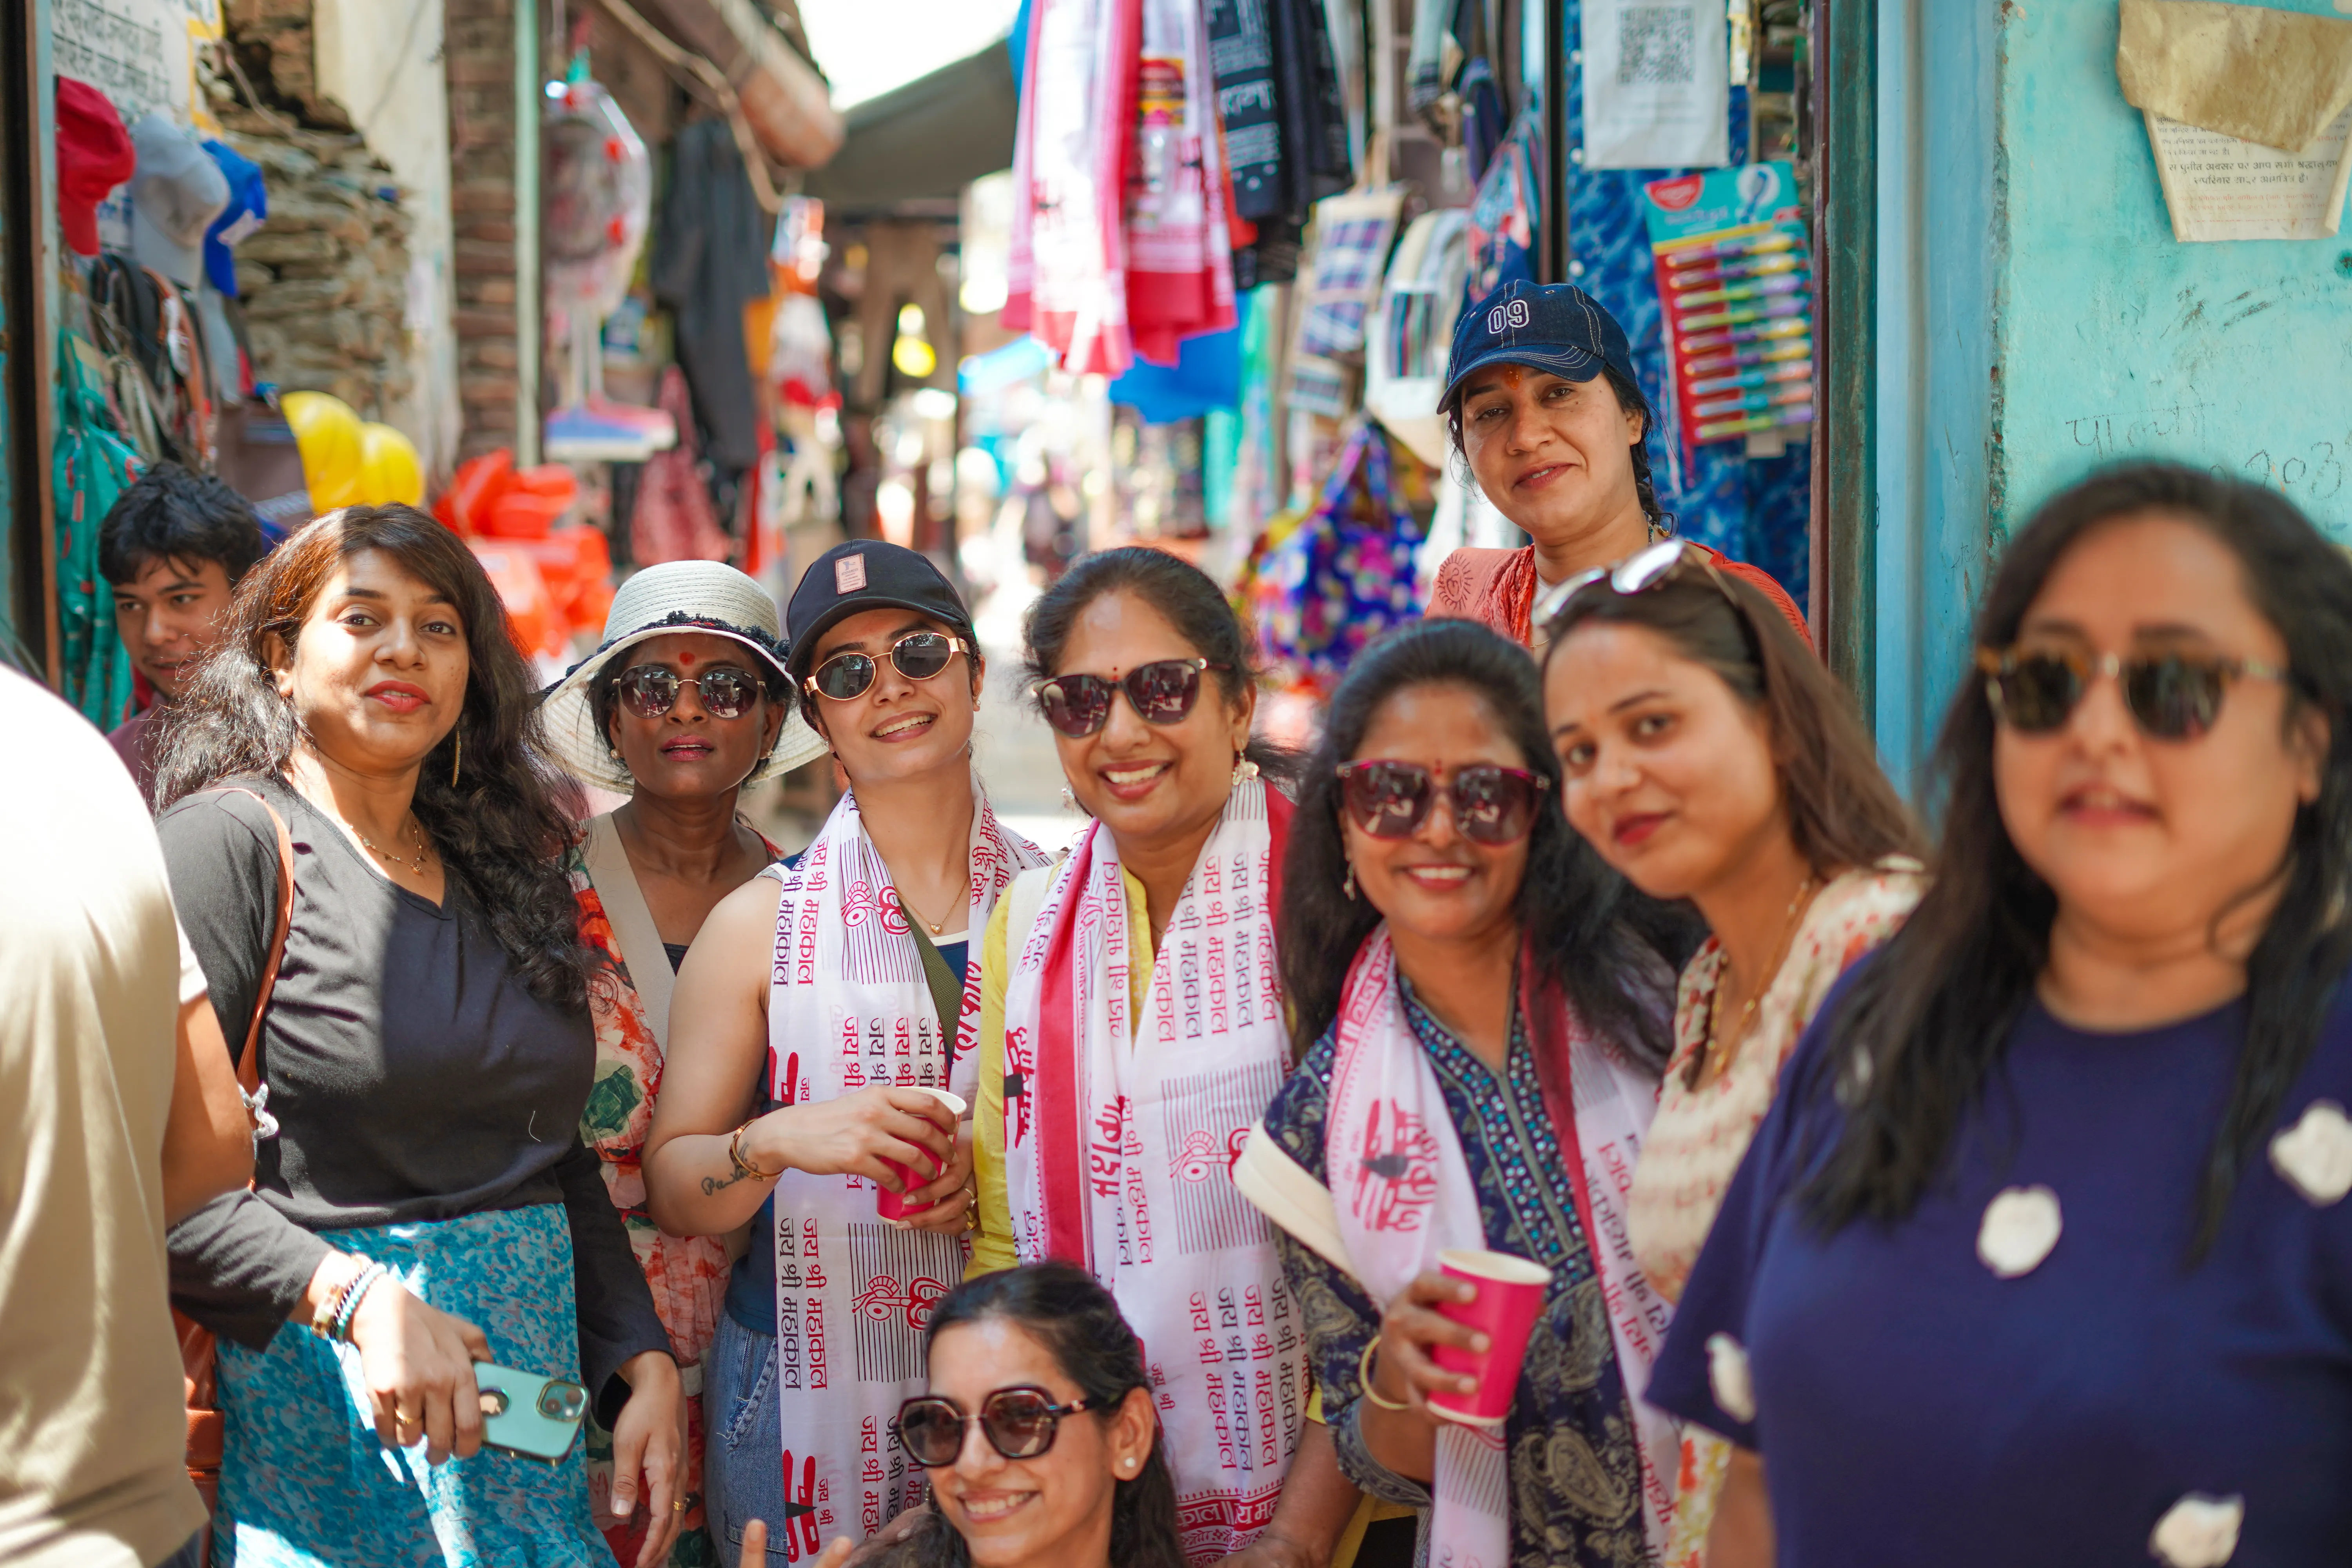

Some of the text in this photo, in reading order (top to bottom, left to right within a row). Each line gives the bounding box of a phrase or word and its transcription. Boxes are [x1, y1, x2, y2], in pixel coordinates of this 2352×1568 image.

[1488, 299, 1529, 334] 09
[783, 875, 803, 893] श्री
[972, 845, 989, 866] श्री
[773, 899, 794, 987] महाकाल
[798, 835, 829, 986] जय श्री महाकाल
[1204, 855, 1229, 1035] जय श्री महाकाल
[1232, 853, 1254, 1029] जय श्री महाकाल
[1180, 875, 1202, 1039] य श्री महाकाल
[843, 1017, 866, 1089] जय श्री
[869, 1018, 885, 1058] जय
[895, 1017, 916, 1087] जय श्री
[918, 1018, 935, 1088] जय श्री
[800, 1077, 810, 1102] जय
[1124, 1129, 1144, 1157] श्री
[1127, 1167, 1153, 1265] महाकाल
[779, 1218, 802, 1391] जय श्री महाकाल
[803, 1218, 828, 1390] जय श्री महाकाल
[1151, 1362, 1176, 1411] जय श्री
[1190, 1290, 1238, 1471] जय श्री महाकाल
[1218, 1287, 1254, 1473] जय श्री महाकाल
[1245, 1284, 1278, 1468] जय श्री महाकाल
[1272, 1278, 1297, 1458] जय श्री महाकाल
[861, 1416, 878, 1454] जय
[889, 1455, 905, 1482] श्री
[818, 1478, 834, 1526] जय श्री
[862, 1459, 885, 1484] श्री
